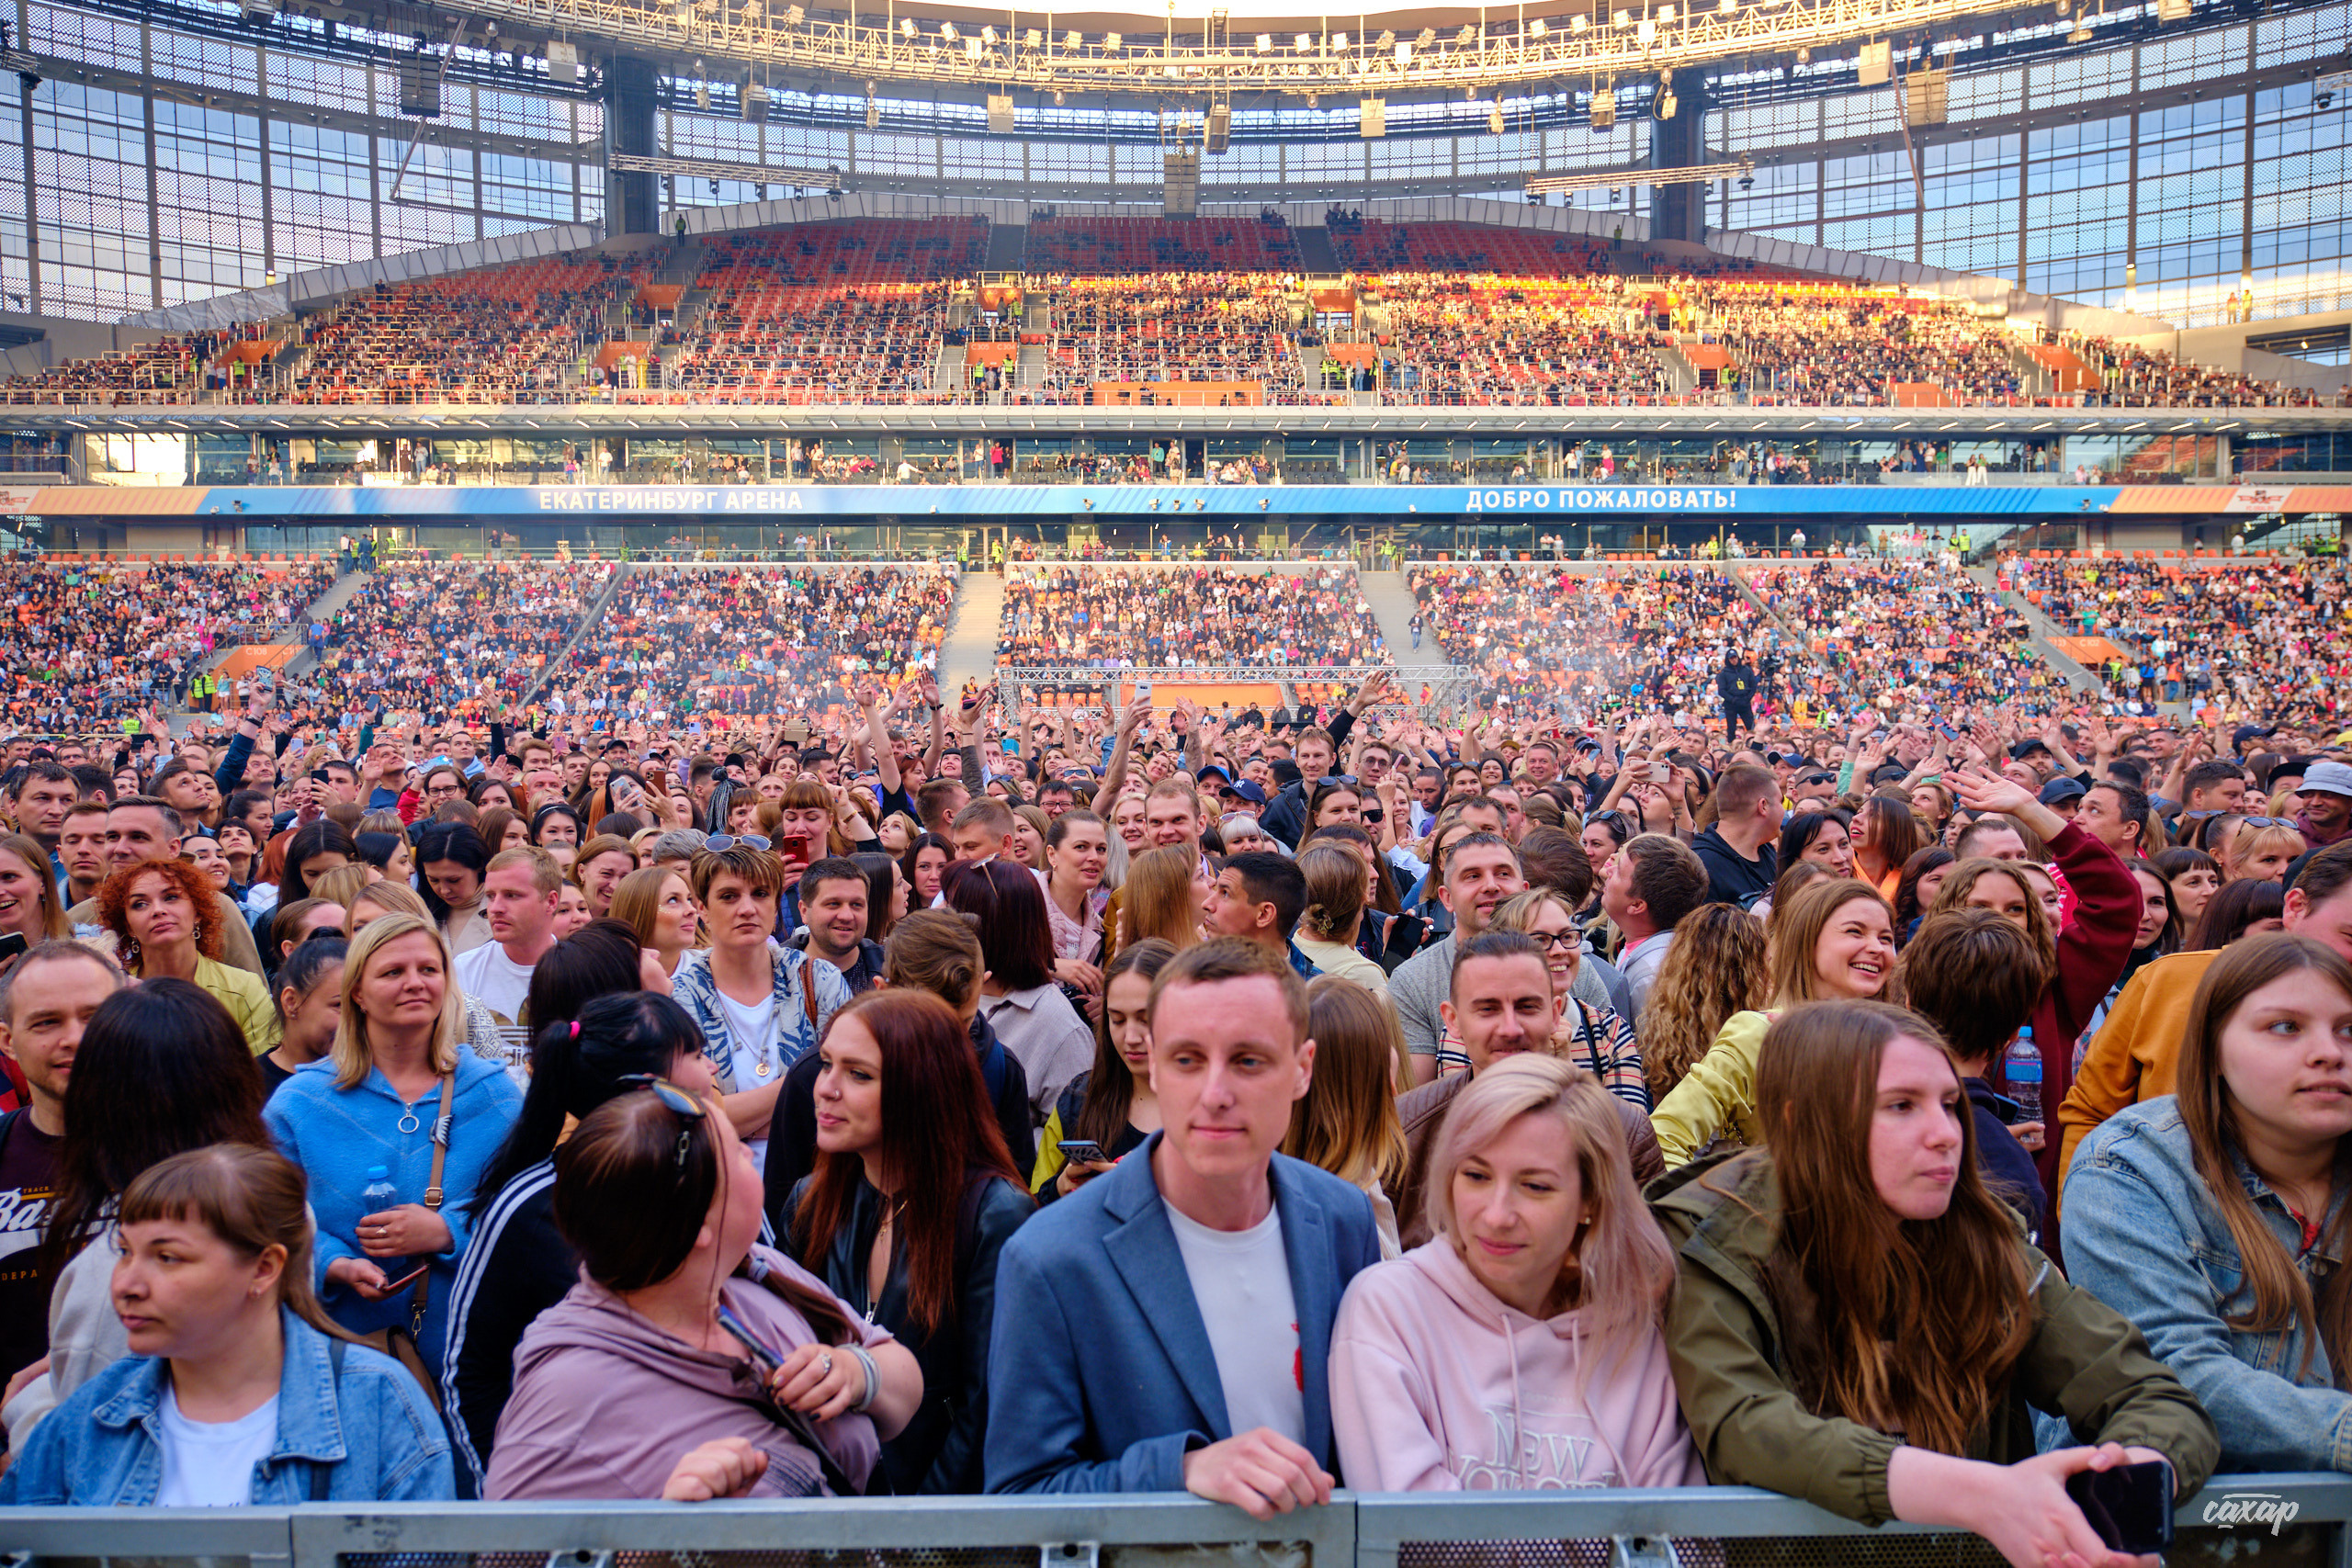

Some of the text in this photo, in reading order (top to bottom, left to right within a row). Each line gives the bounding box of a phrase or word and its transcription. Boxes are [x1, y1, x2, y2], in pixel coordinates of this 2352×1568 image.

[539, 491, 803, 510] ЕКАТЕРИНБУРГ АРЕНА
[1465, 490, 1736, 512] ДОБРО ПОЖАЛОВАТЬ!
[245, 647, 268, 656] C108
